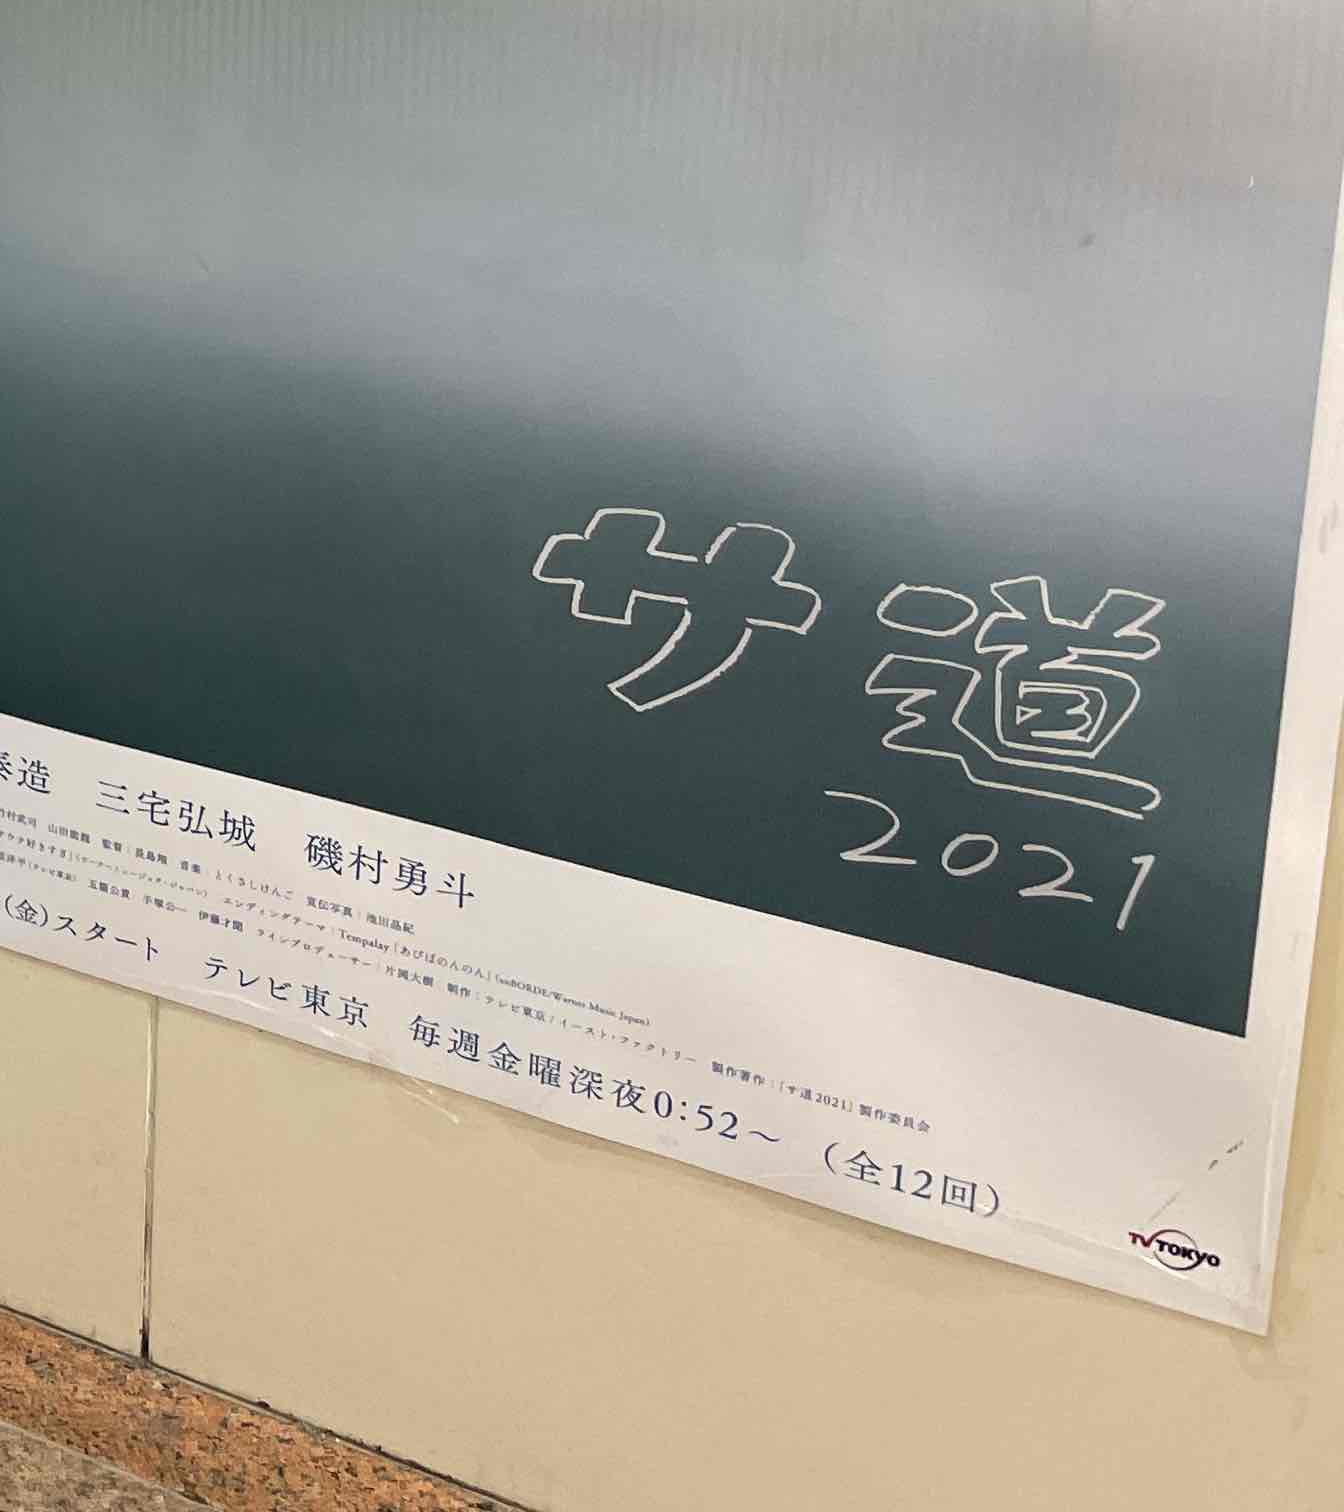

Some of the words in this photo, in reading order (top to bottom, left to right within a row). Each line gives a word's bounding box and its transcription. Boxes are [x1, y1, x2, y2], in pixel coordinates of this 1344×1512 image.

[533, 508, 1166, 818] サ道
[95, 780, 255, 851] 三宅弘城
[304, 833, 474, 908] 磯村勇斗
[825, 790, 1154, 929] 2021
[205, 956, 368, 1028] テレビ東京
